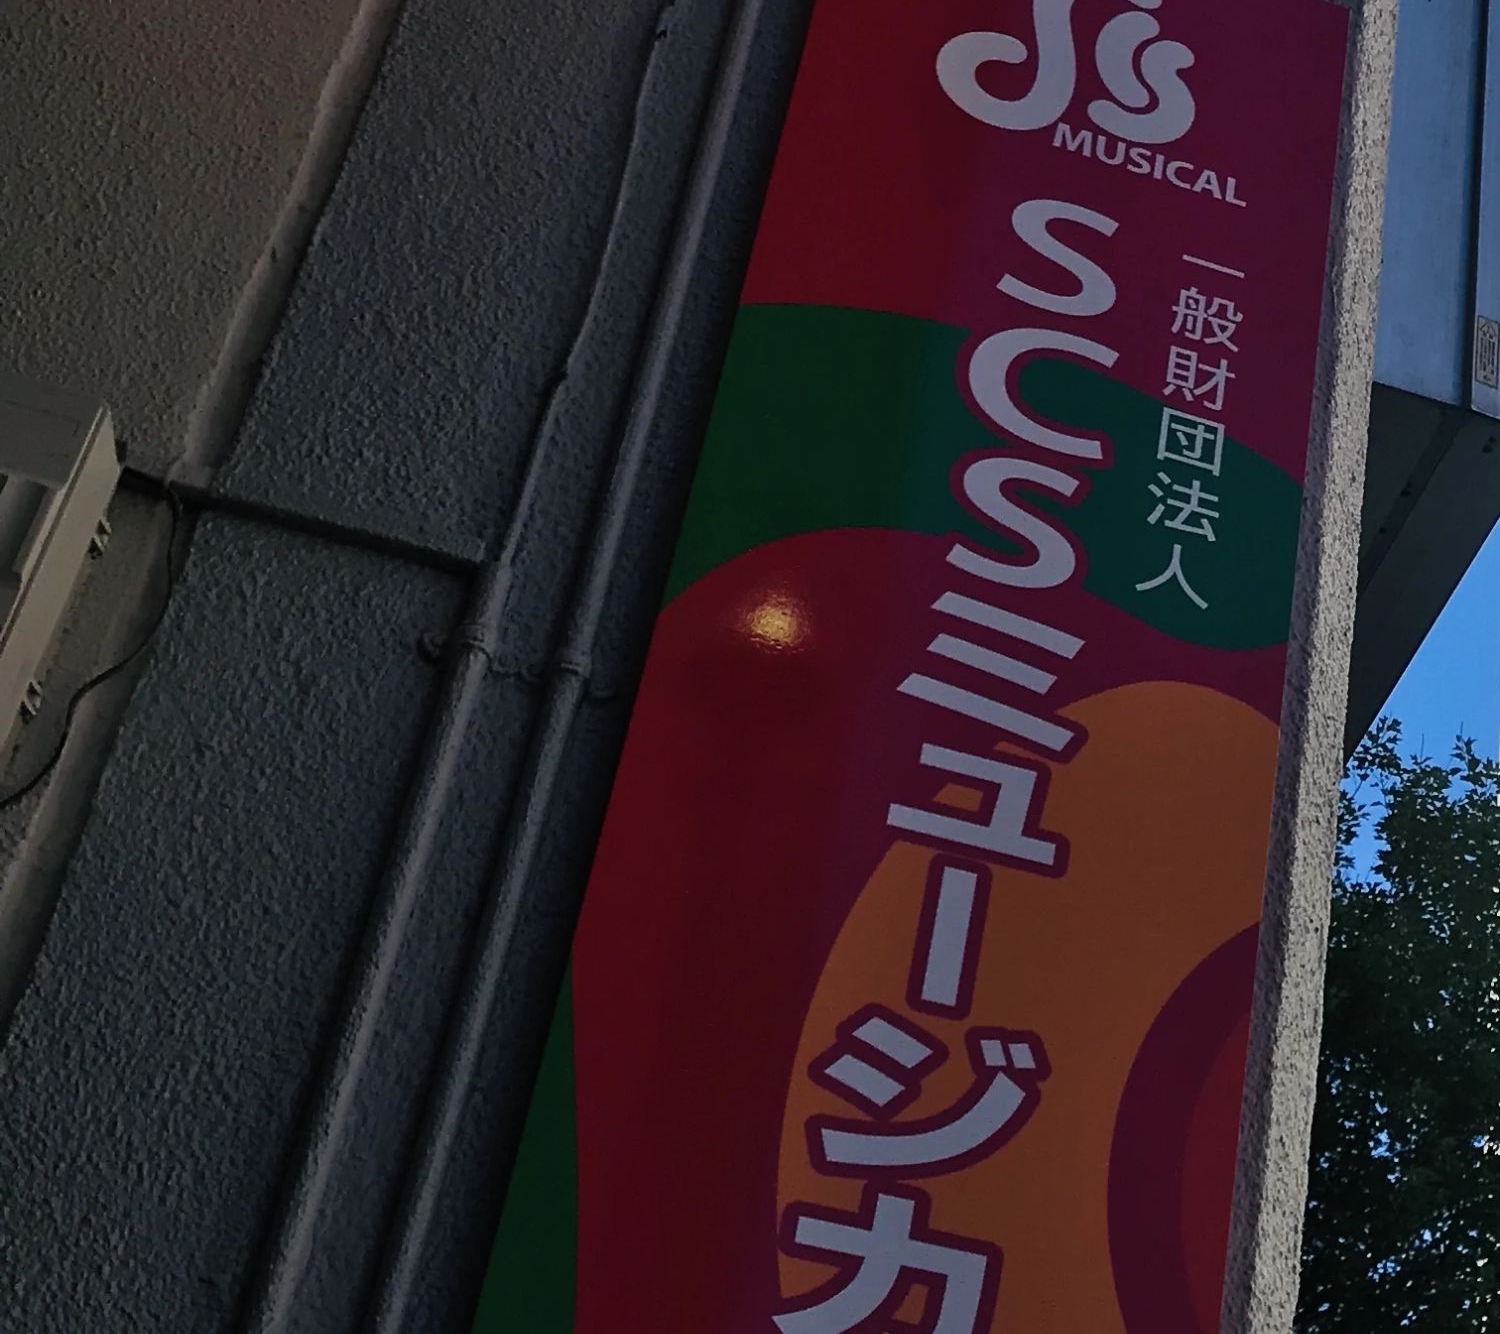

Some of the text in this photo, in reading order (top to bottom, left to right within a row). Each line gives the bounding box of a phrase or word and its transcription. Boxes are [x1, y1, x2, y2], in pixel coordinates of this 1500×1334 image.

[1053, 122, 1247, 208] MUSICAL
[1135, 251, 1246, 611] 一般財団法人
